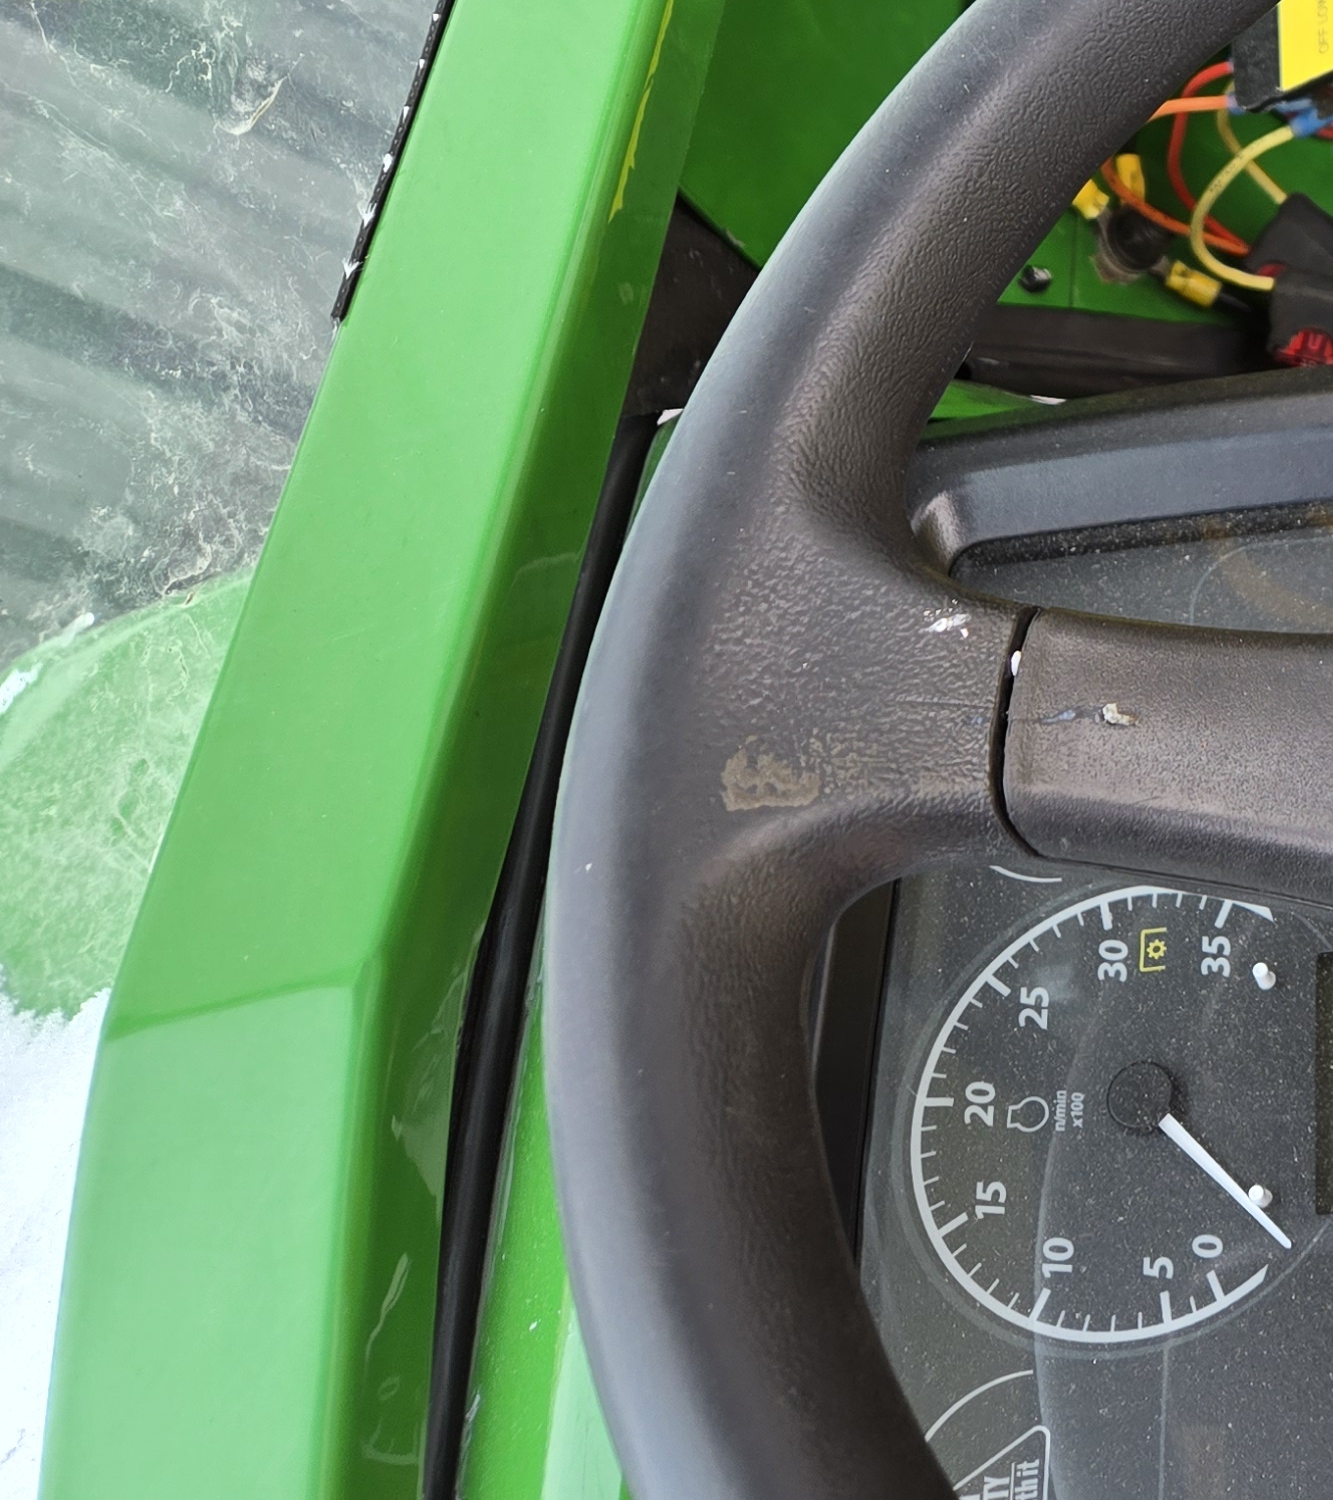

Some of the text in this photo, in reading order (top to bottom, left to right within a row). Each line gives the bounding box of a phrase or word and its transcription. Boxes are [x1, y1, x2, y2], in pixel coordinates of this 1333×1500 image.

[1317, 27, 1329, 53] OFF
[1098, 938, 1128, 982] 30
[1201, 934, 1232, 978] 35
[1019, 985, 1050, 1030] 25
[964, 1082, 995, 1126] 20
[1053, 1089, 1069, 1132] n/min
[1070, 1092, 1086, 1129] x100
[976, 1180, 1007, 1219] 15
[1042, 1237, 1074, 1279] 10
[1143, 1255, 1174, 1280] 5
[1191, 1234, 1224, 1259] 0
